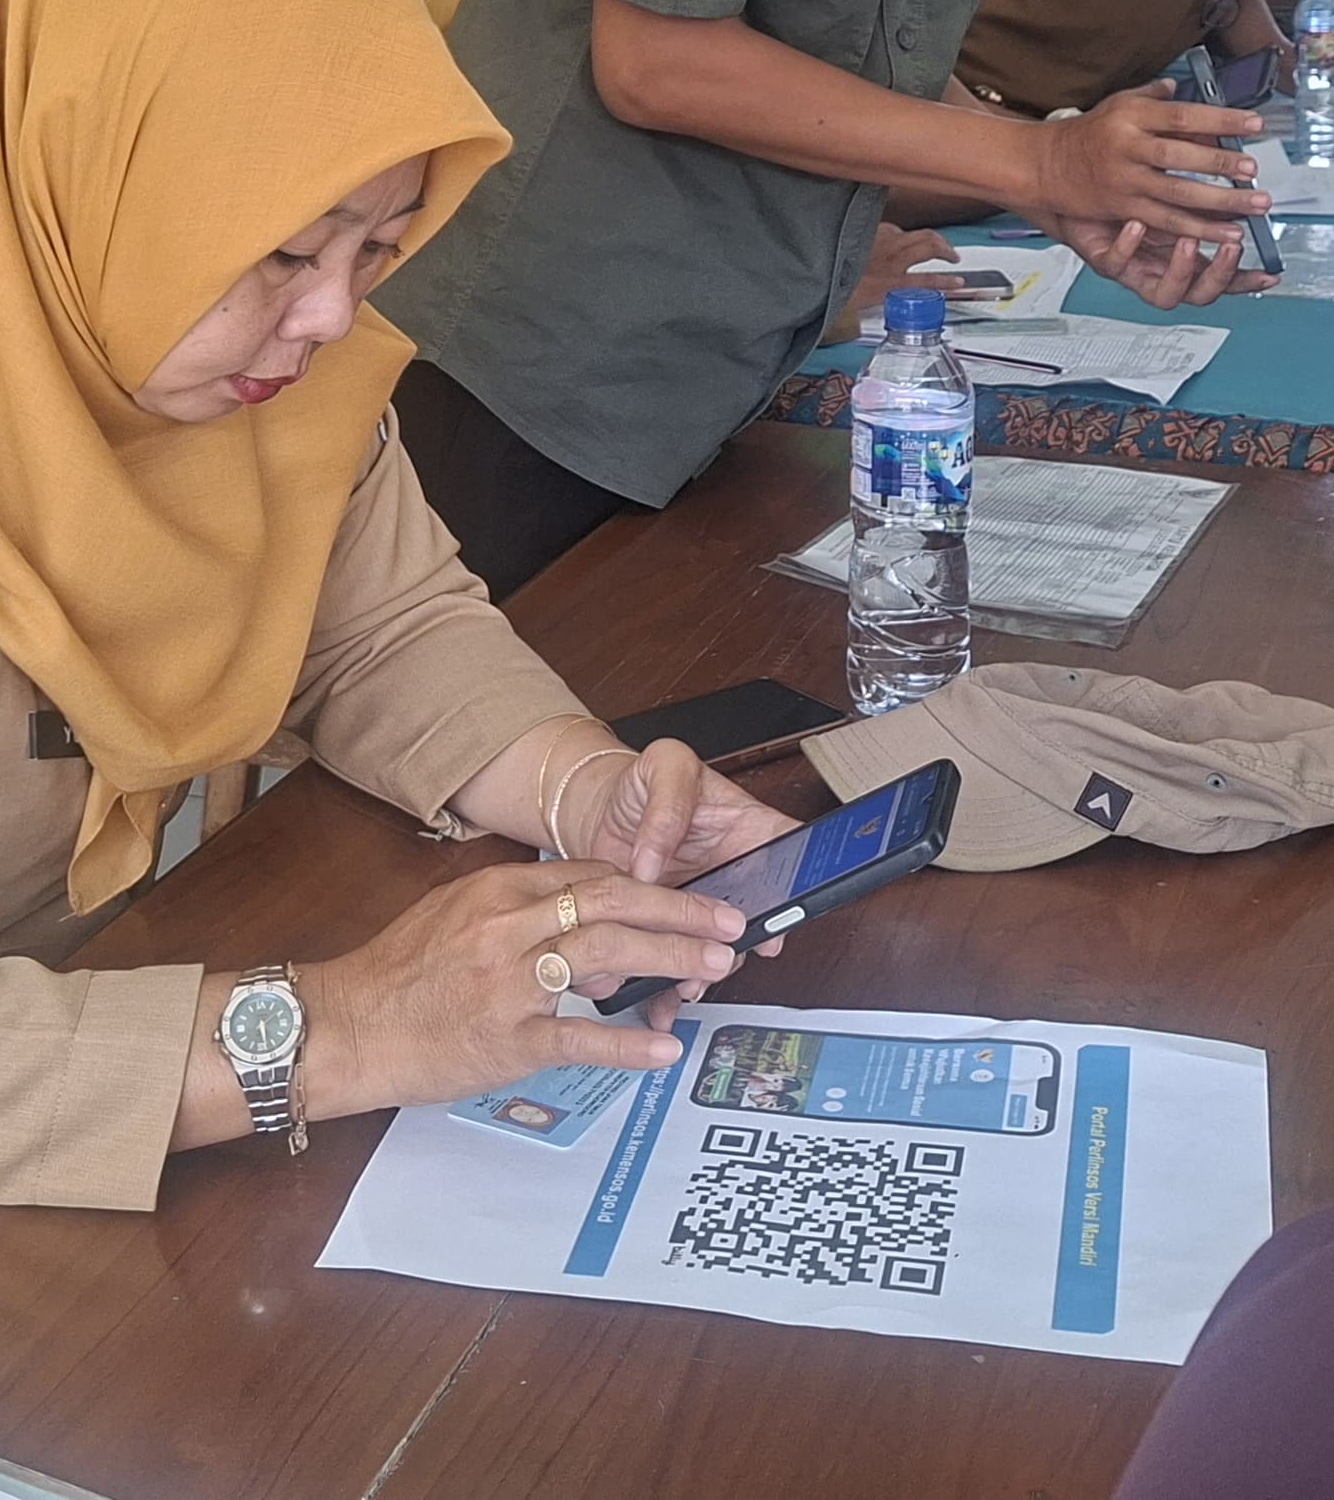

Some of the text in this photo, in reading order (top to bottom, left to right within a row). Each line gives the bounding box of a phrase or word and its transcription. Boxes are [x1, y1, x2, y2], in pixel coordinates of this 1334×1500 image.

[596, 1066, 672, 1224] ttps://perlinsos.kemensos.go.id
[1078, 1106, 1108, 1268] Portal Perlinsos Versi Mandiri
